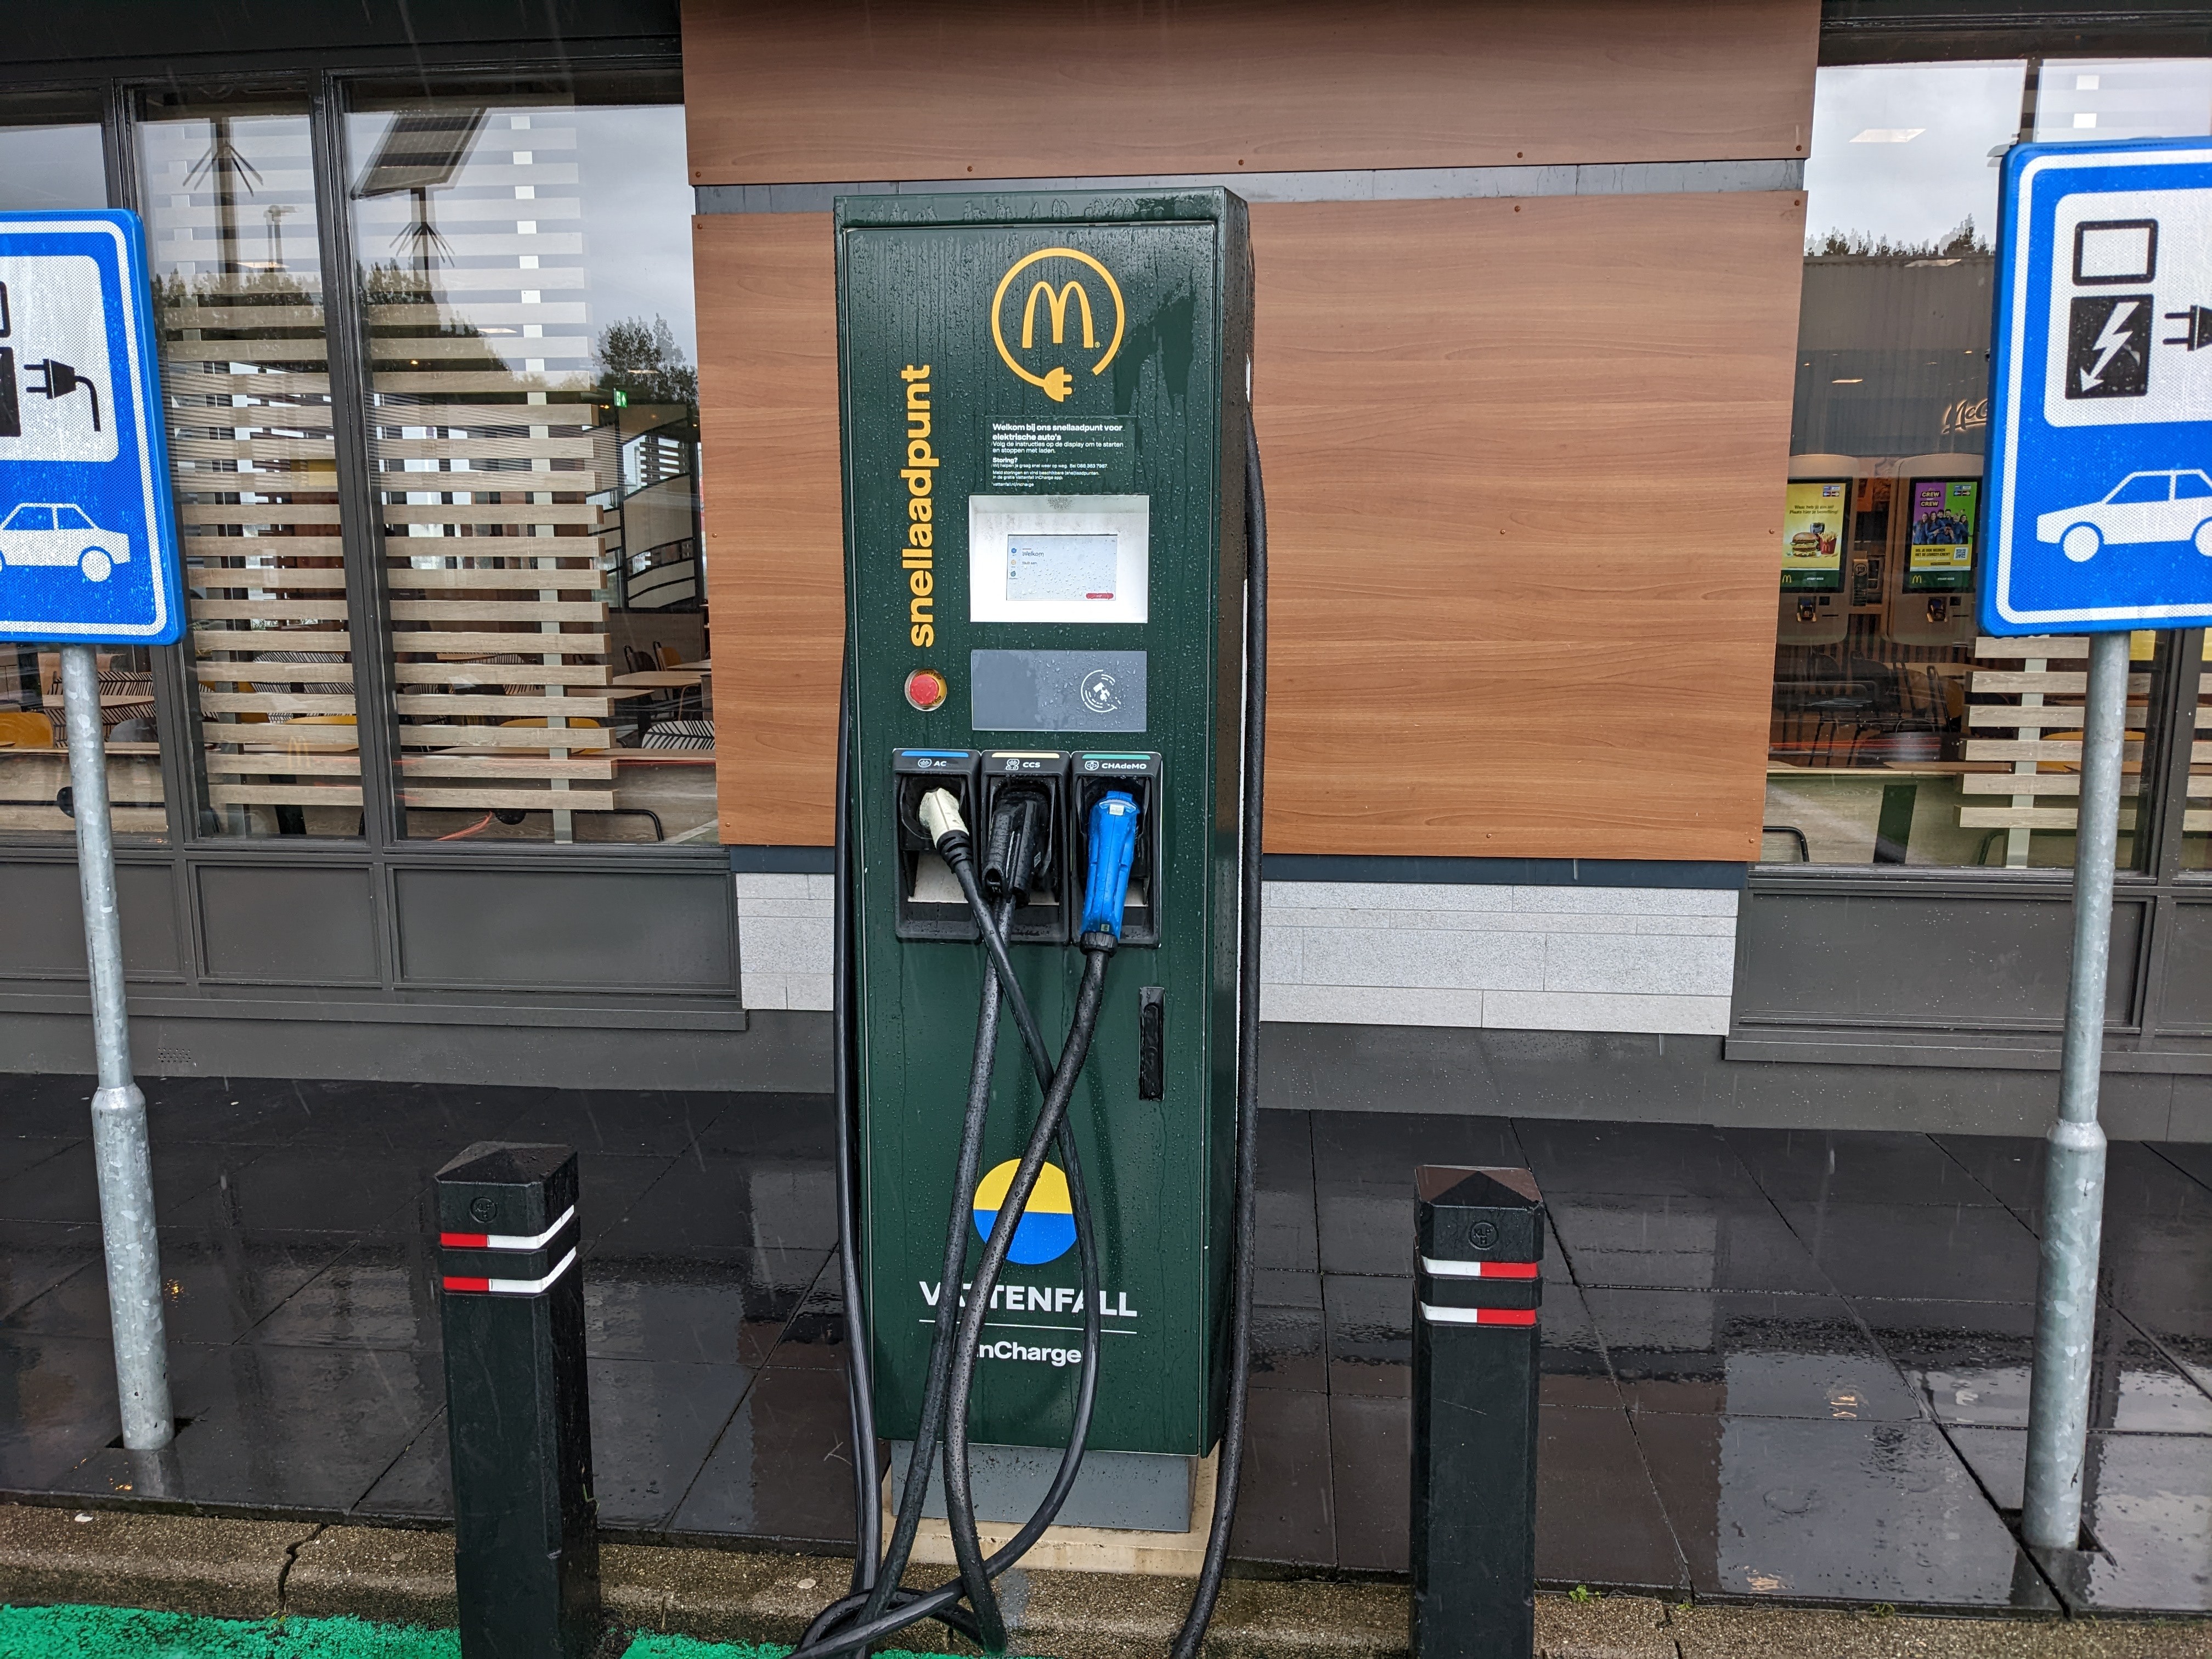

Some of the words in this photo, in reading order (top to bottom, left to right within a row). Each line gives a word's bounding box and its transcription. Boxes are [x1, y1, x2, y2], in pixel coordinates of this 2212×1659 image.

[1026, 424, 1036, 432] bij
[1052, 424, 1103, 432] snellaadpunt
[901, 364, 940, 648] snellaadpunt
[977, 1341, 1082, 1367] nCharge
